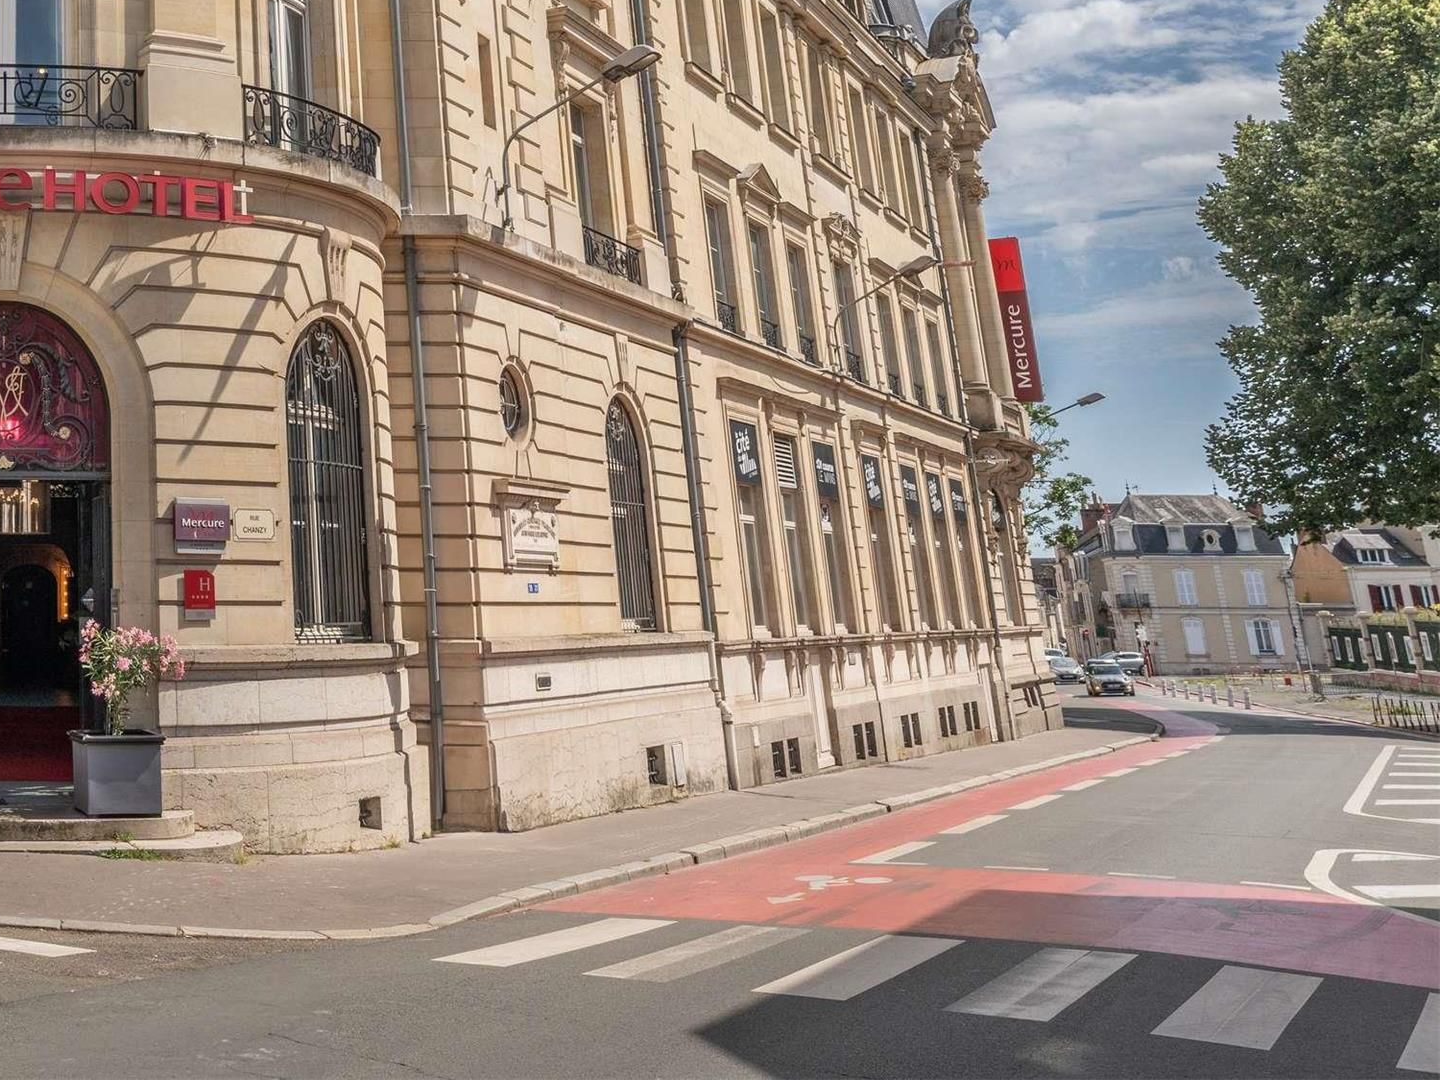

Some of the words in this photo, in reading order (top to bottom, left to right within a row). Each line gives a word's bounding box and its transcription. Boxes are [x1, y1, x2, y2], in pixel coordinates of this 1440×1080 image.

[43, 168, 255, 225] HOTEL
[1007, 304, 1033, 389] Mercure
[181, 518, 225, 528] Mercure
[199, 577, 210, 591] H
